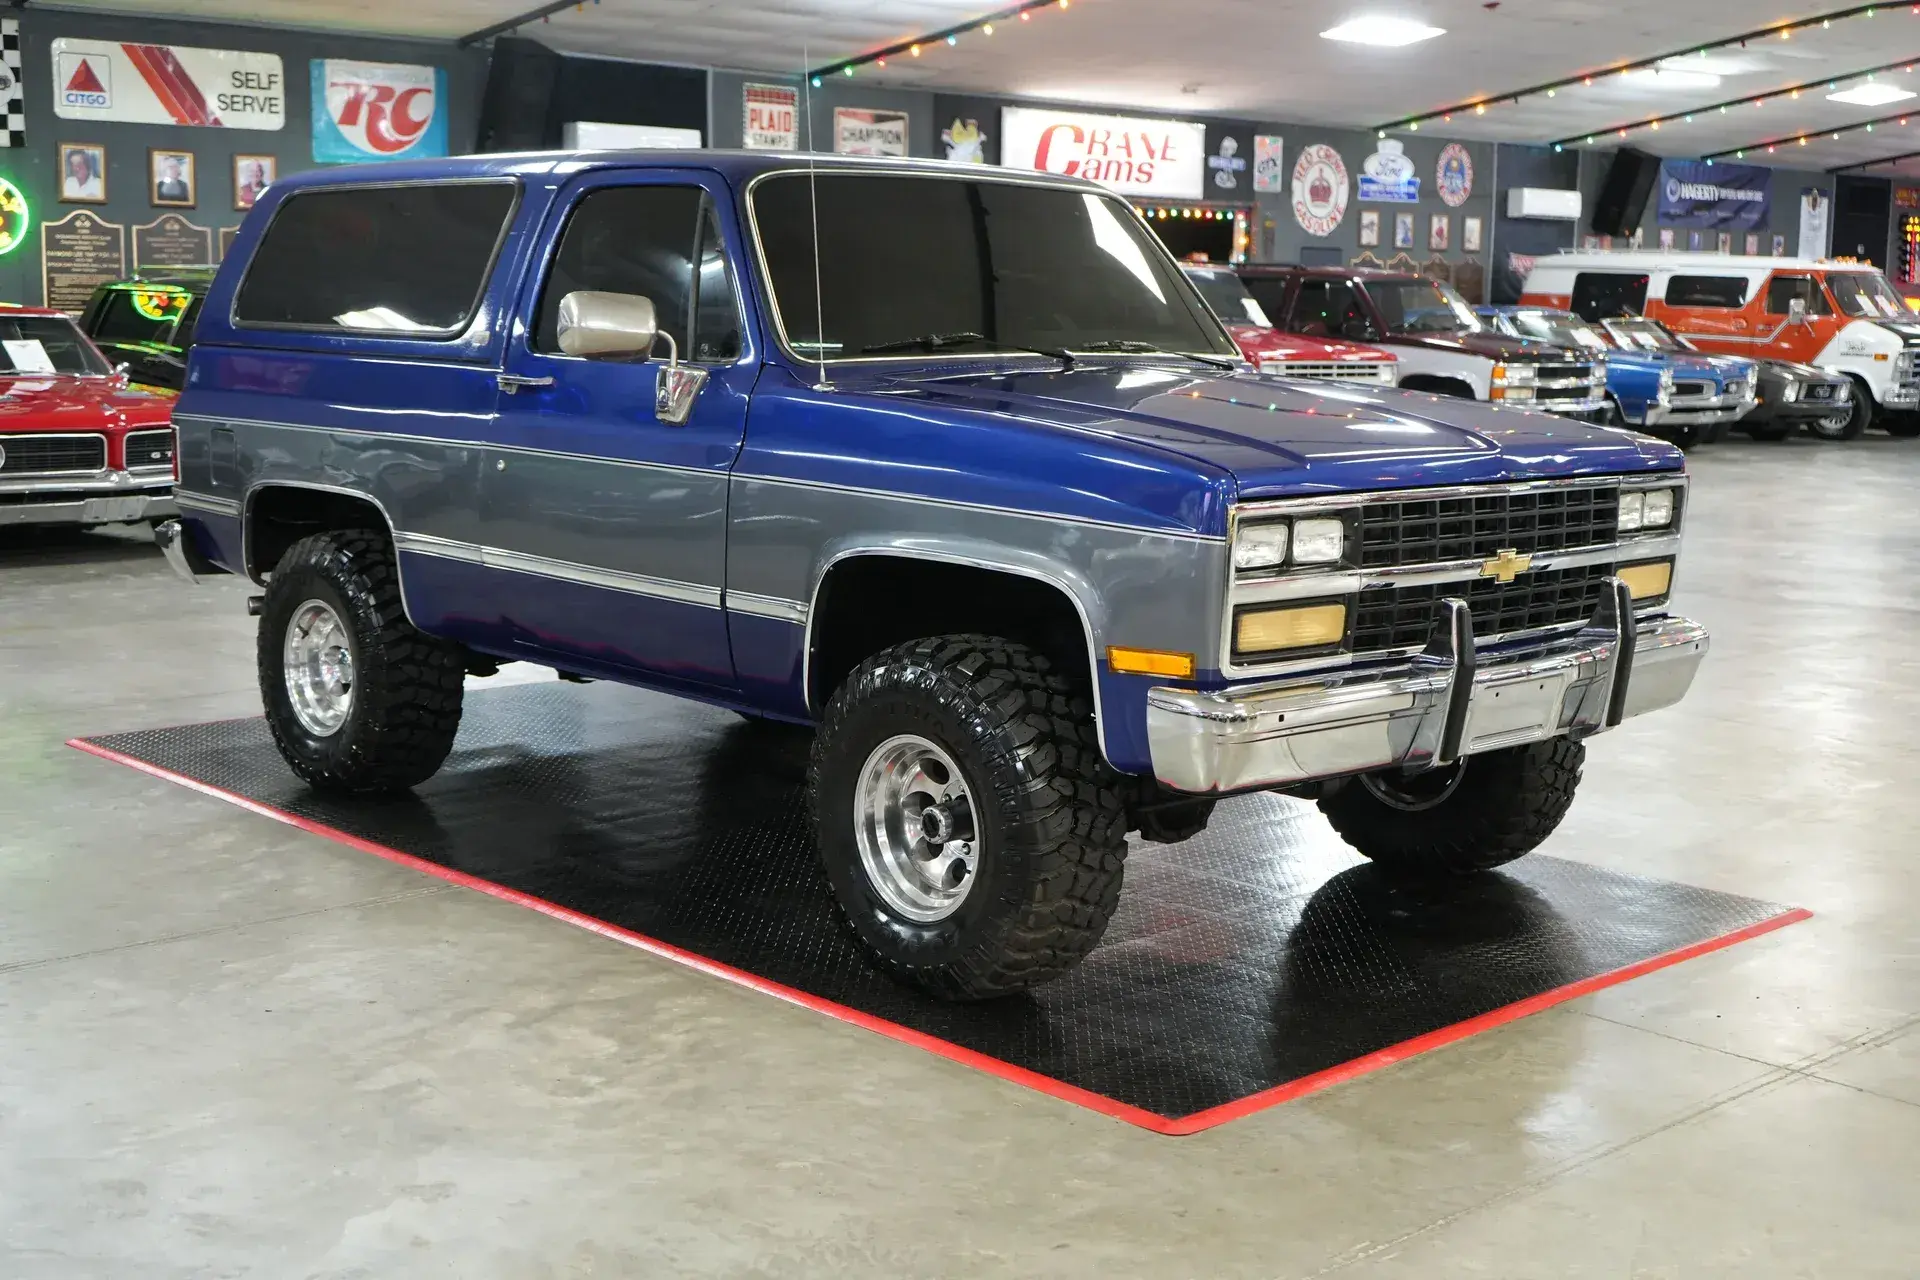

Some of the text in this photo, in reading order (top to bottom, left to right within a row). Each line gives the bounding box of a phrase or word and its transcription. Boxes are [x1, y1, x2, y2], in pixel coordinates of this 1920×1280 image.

[231, 71, 279, 91] SELF
[66, 92, 106, 106] CITGO
[217, 93, 280, 114] SERVE
[330, 82, 432, 152] RC
[750, 108, 792, 132] PLAID
[842, 127, 903, 145] CHAMPION
[1034, 124, 1177, 176] CRANE
[1680, 183, 1720, 202] HAGERTY
[1295, 200, 1343, 233] GASOLINE
